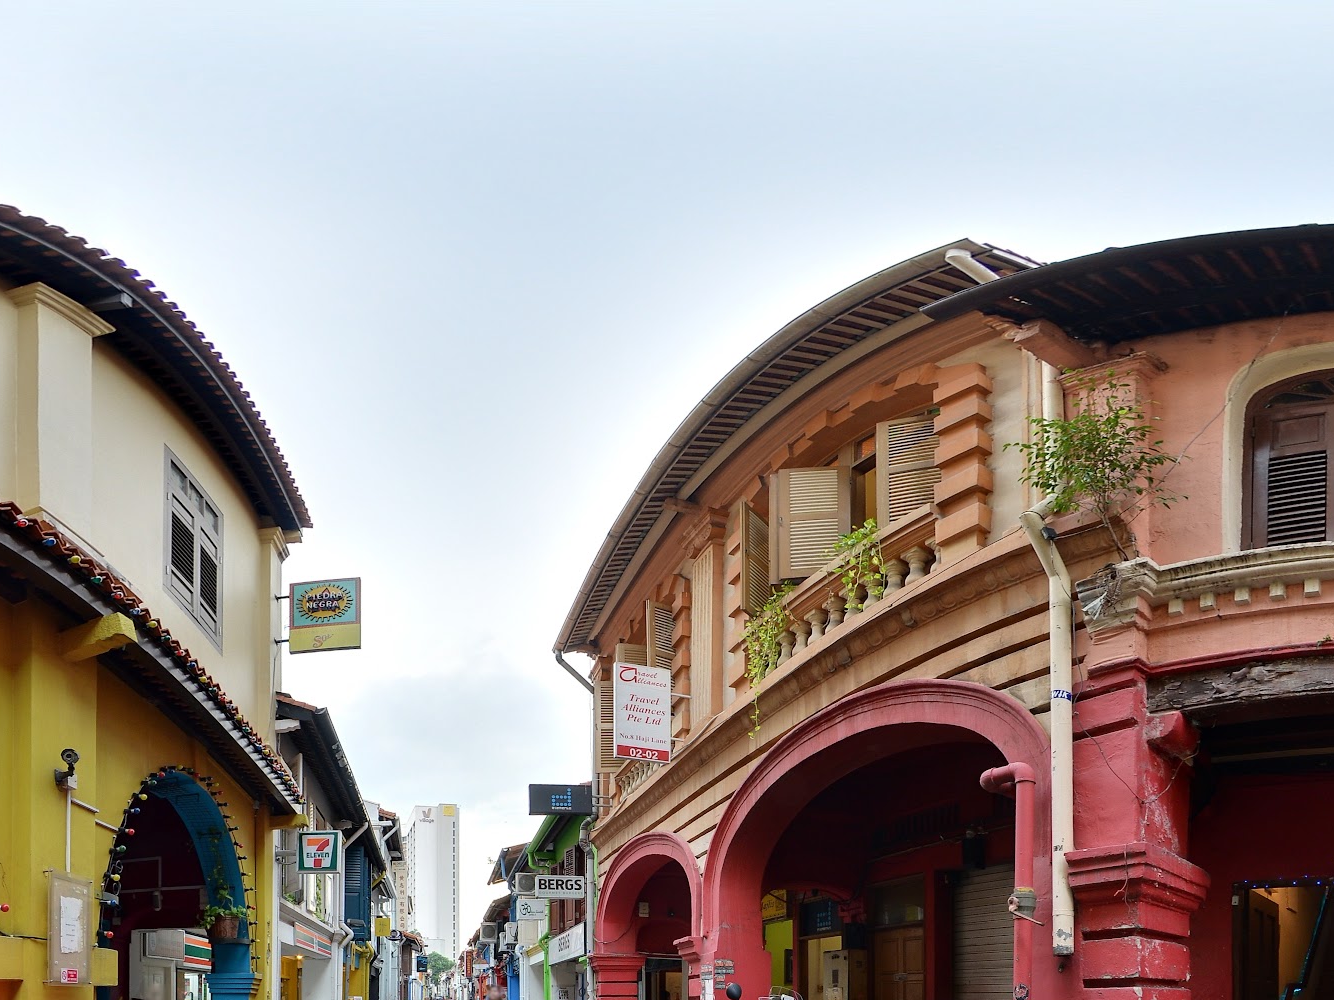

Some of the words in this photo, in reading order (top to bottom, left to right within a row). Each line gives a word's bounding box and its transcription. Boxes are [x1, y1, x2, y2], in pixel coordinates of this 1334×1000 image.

[306, 591, 344, 601] PIEDRA
[307, 601, 339, 610] NEGRA
[630, 694, 660, 705] Travel
[621, 703, 666, 716] Alliances
[627, 714, 642, 723] Pte
[645, 716, 662, 726] Ltd
[630, 748, 658, 760] 02-02
[538, 878, 583, 891] BERGS
